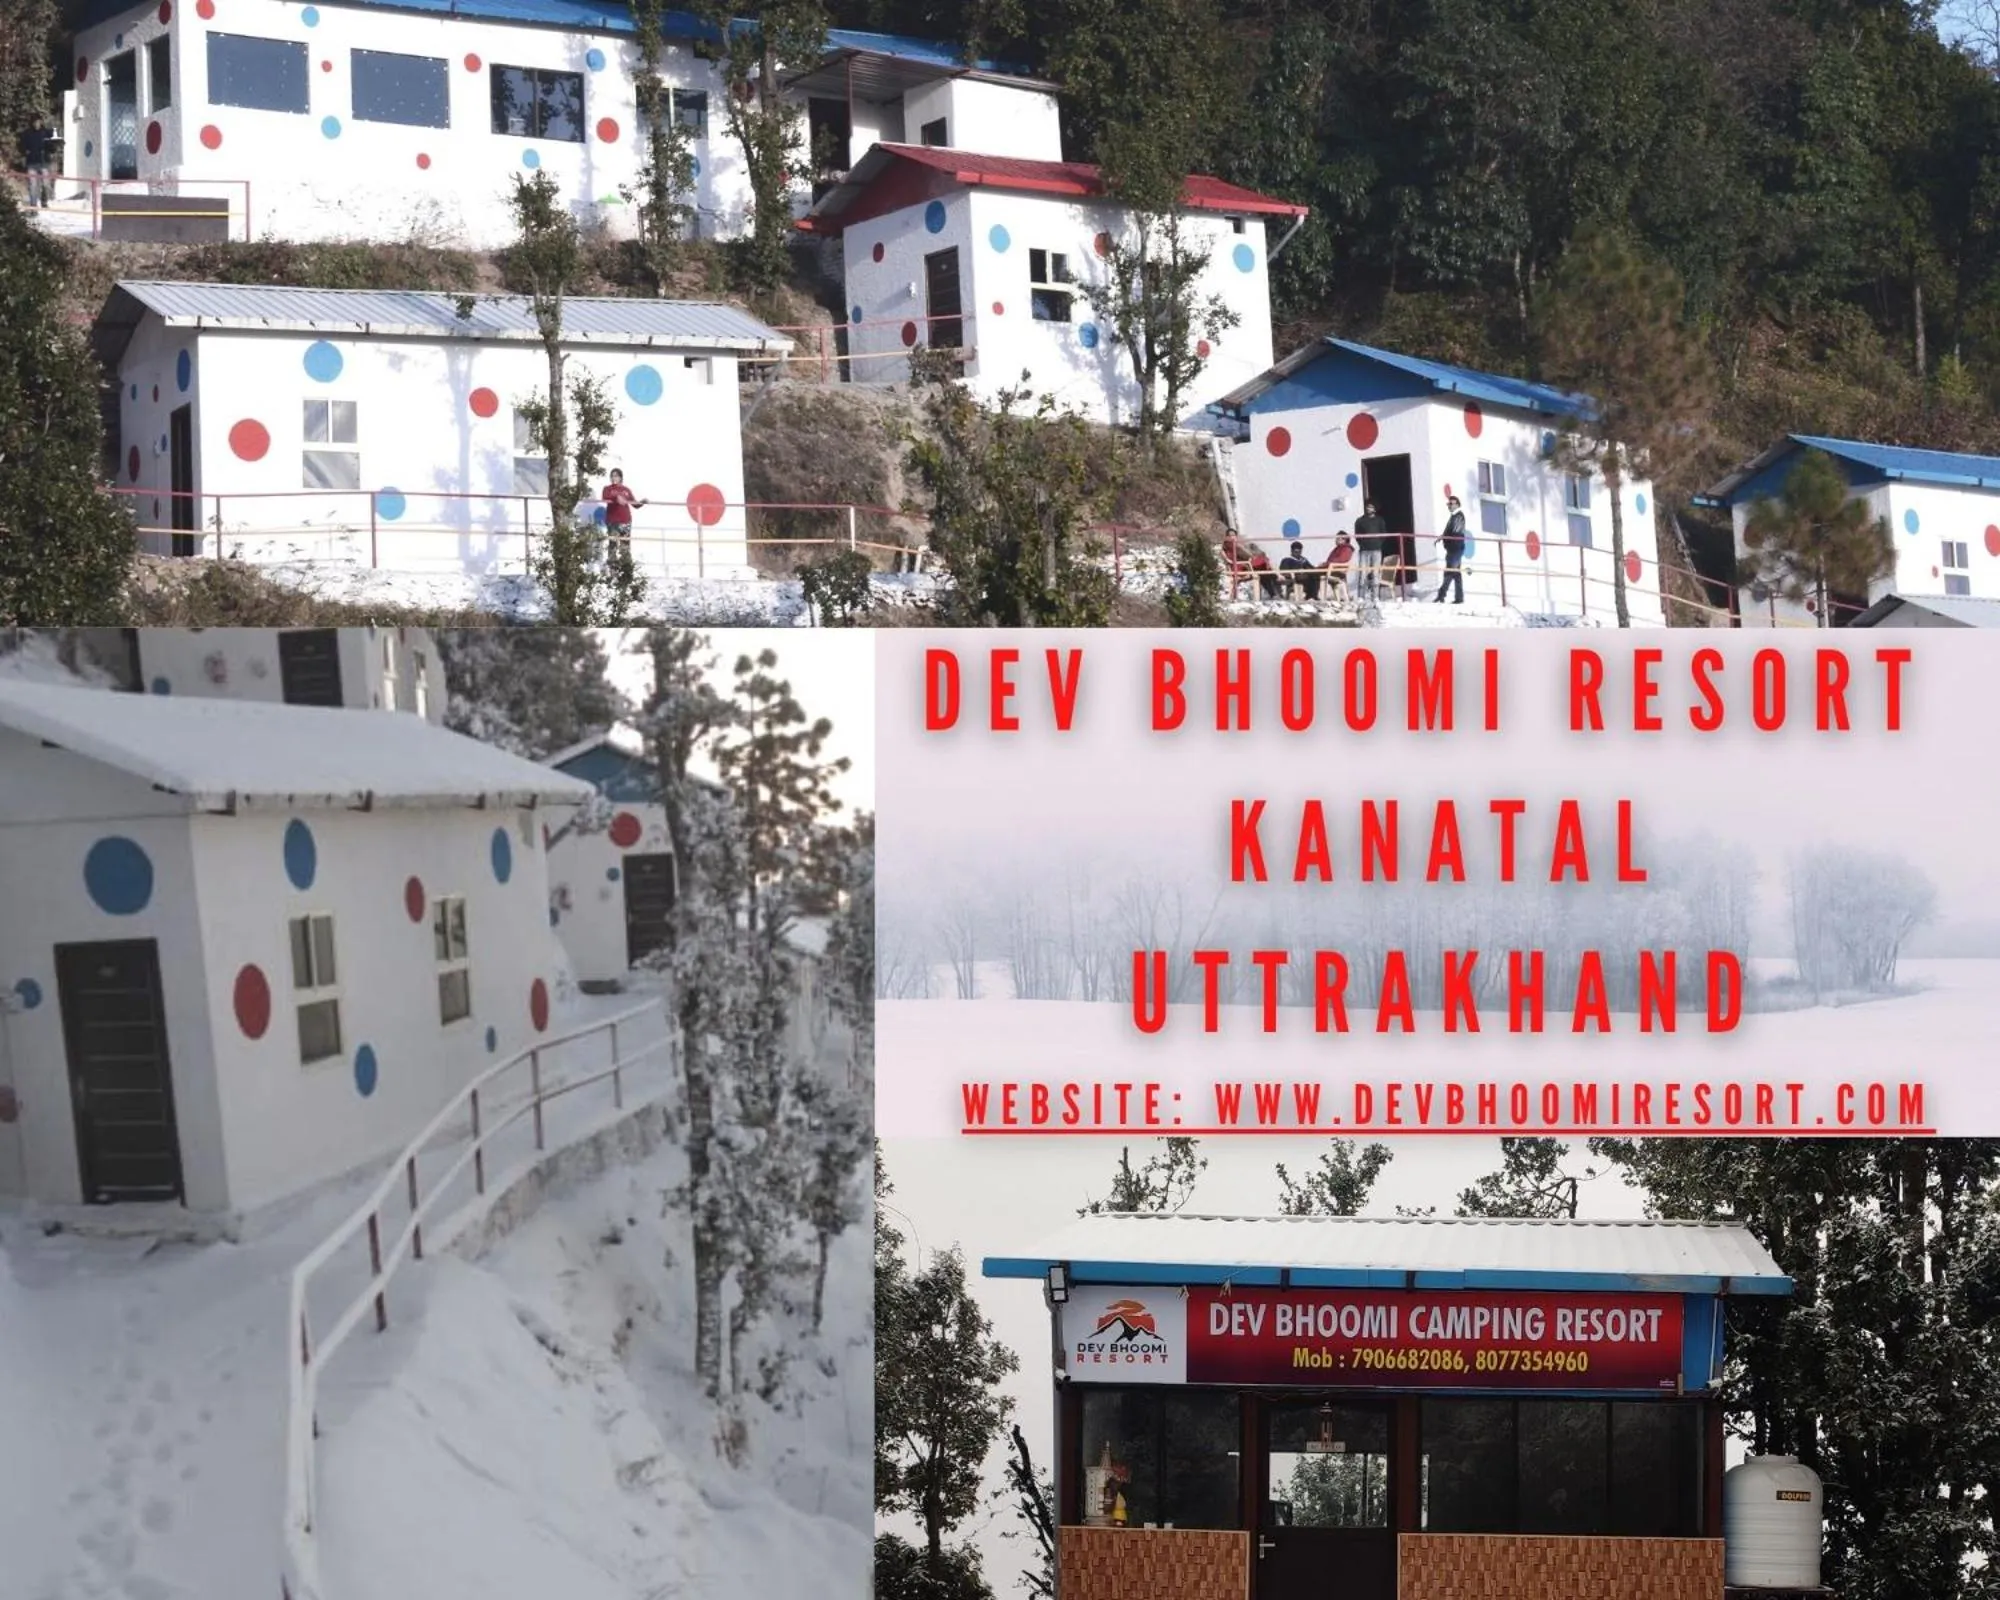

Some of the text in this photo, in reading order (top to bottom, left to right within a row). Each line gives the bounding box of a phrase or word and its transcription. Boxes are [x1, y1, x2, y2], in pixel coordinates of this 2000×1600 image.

[1210, 1303, 1662, 1343] DEV BHOOMI CAMPING RESORT
[1077, 1343, 1168, 1353] DEV BHOOMI
[1076, 1354, 1168, 1363] RESORT
[1293, 1347, 1332, 1368] Mob
[1352, 1348, 1470, 1373] 7906682086,
[1475, 1350, 1588, 1372] 8077354960
